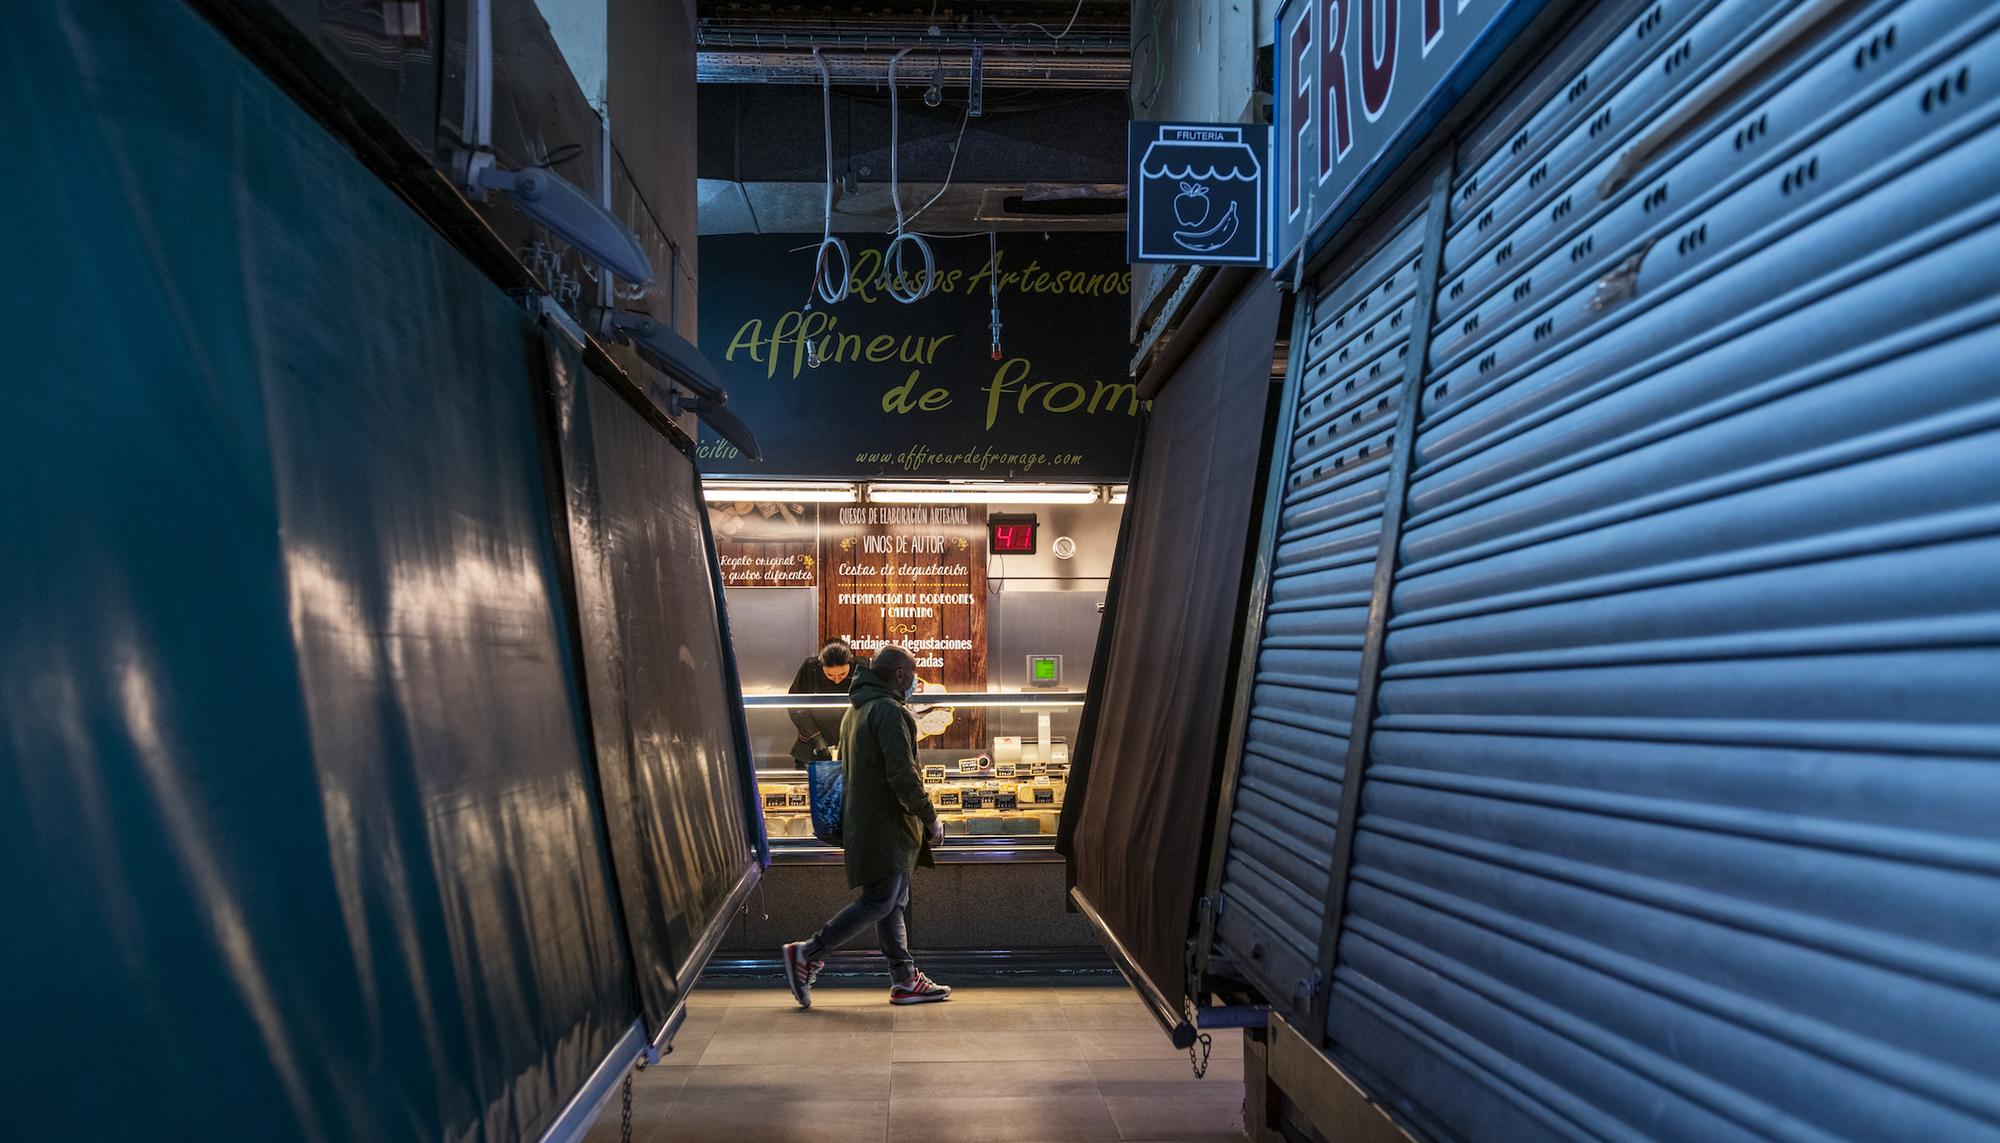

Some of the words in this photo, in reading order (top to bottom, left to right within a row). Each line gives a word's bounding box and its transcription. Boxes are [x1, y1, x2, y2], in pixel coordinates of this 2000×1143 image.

[1288, 0, 1472, 224] FRU
[1176, 130, 1225, 141] FRUTERÍA
[848, 248, 962, 304] Quesos
[966, 252, 1132, 297] Artesanos
[725, 311, 957, 380] Affineur
[882, 370, 954, 415] de
[981, 357, 1154, 432] from
[695, 438, 739, 460] icilio
[856, 444, 1083, 472] www.affineurdefromage.com
[839, 507, 867, 525] QUESOS
[869, 507, 878, 524] DE
[880, 504, 928, 525] ELABORACIÓN
[930, 507, 969, 525] ARTESANAL
[863, 535, 893, 554] VINOS
[896, 535, 908, 553] DE
[911, 535, 945, 553] AUTOR
[997, 527, 1031, 549] 41
[720, 554, 753, 570] Regalo
[755, 554, 796, 570] original
[839, 562, 878, 576] Cestas
[880, 562, 896, 576] de
[898, 562, 969, 581] degustación
[728, 569, 762, 584] gustos
[764, 569, 814, 584] diferentes
[838, 592, 903, 605] PREPARACIÓN
[905, 593, 916, 605] DE
[880, 606, 886, 618] Y
[888, 606, 933, 618] CATERING
[841, 634, 890, 650] Maridajes
[902, 635, 973, 652] degustaciones
